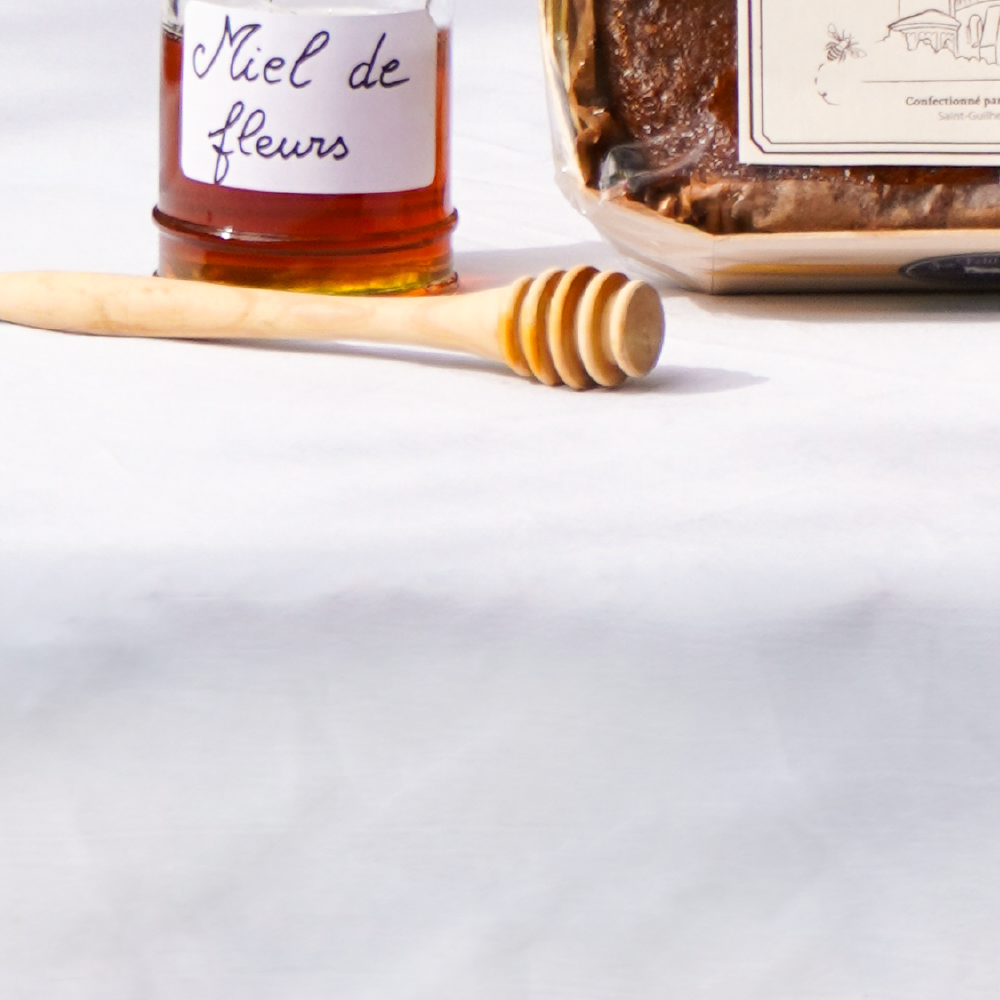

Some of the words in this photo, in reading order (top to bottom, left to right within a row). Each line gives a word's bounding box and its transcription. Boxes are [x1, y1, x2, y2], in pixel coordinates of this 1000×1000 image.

[192, 14, 330, 89] Miel
[348, 32, 411, 90] de
[905, 94, 980, 106] Confectionné
[983, 97, 1000, 108] par
[207, 100, 351, 185] fleurs
